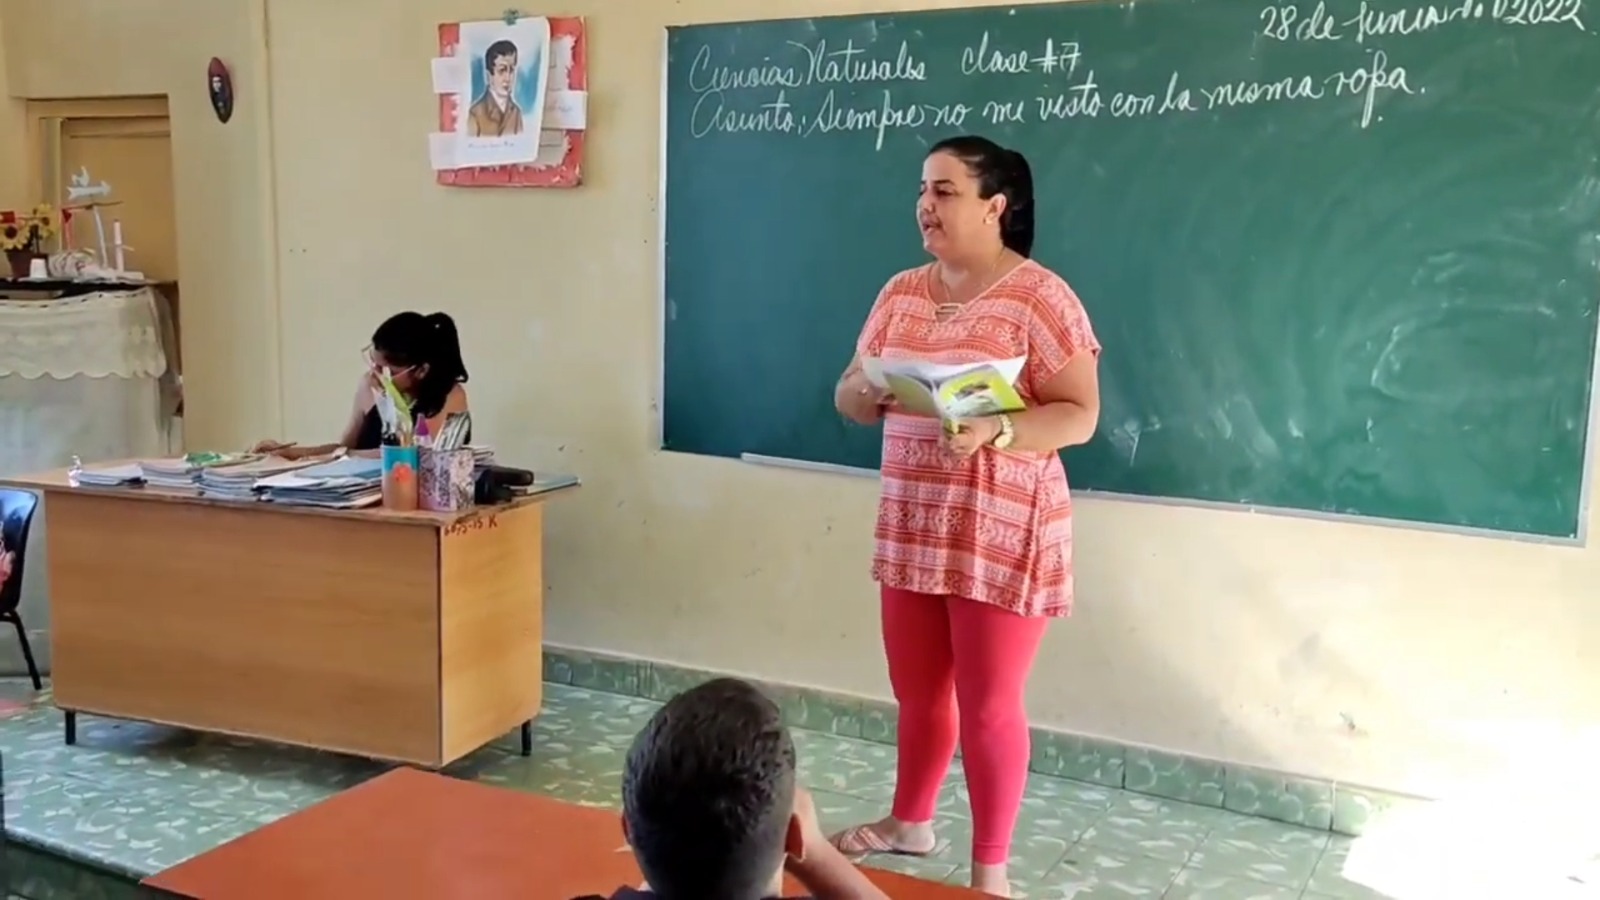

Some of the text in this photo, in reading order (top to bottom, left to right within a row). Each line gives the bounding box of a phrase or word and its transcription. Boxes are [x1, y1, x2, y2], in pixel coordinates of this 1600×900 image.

[1260, 5, 1298, 41] 28
[1295, 0, 1343, 41] de
[1501, 0, 1586, 31] 2022
[689, 43, 803, 93] Ciencias
[785, 39, 927, 85] Naturales
[803, 89, 925, 151] Siempre
[923, 103, 973, 126] no
[982, 100, 1026, 124] me
[1110, 92, 1155, 118] con
[1157, 70, 1198, 115] la
[1200, 79, 1325, 110] misma
